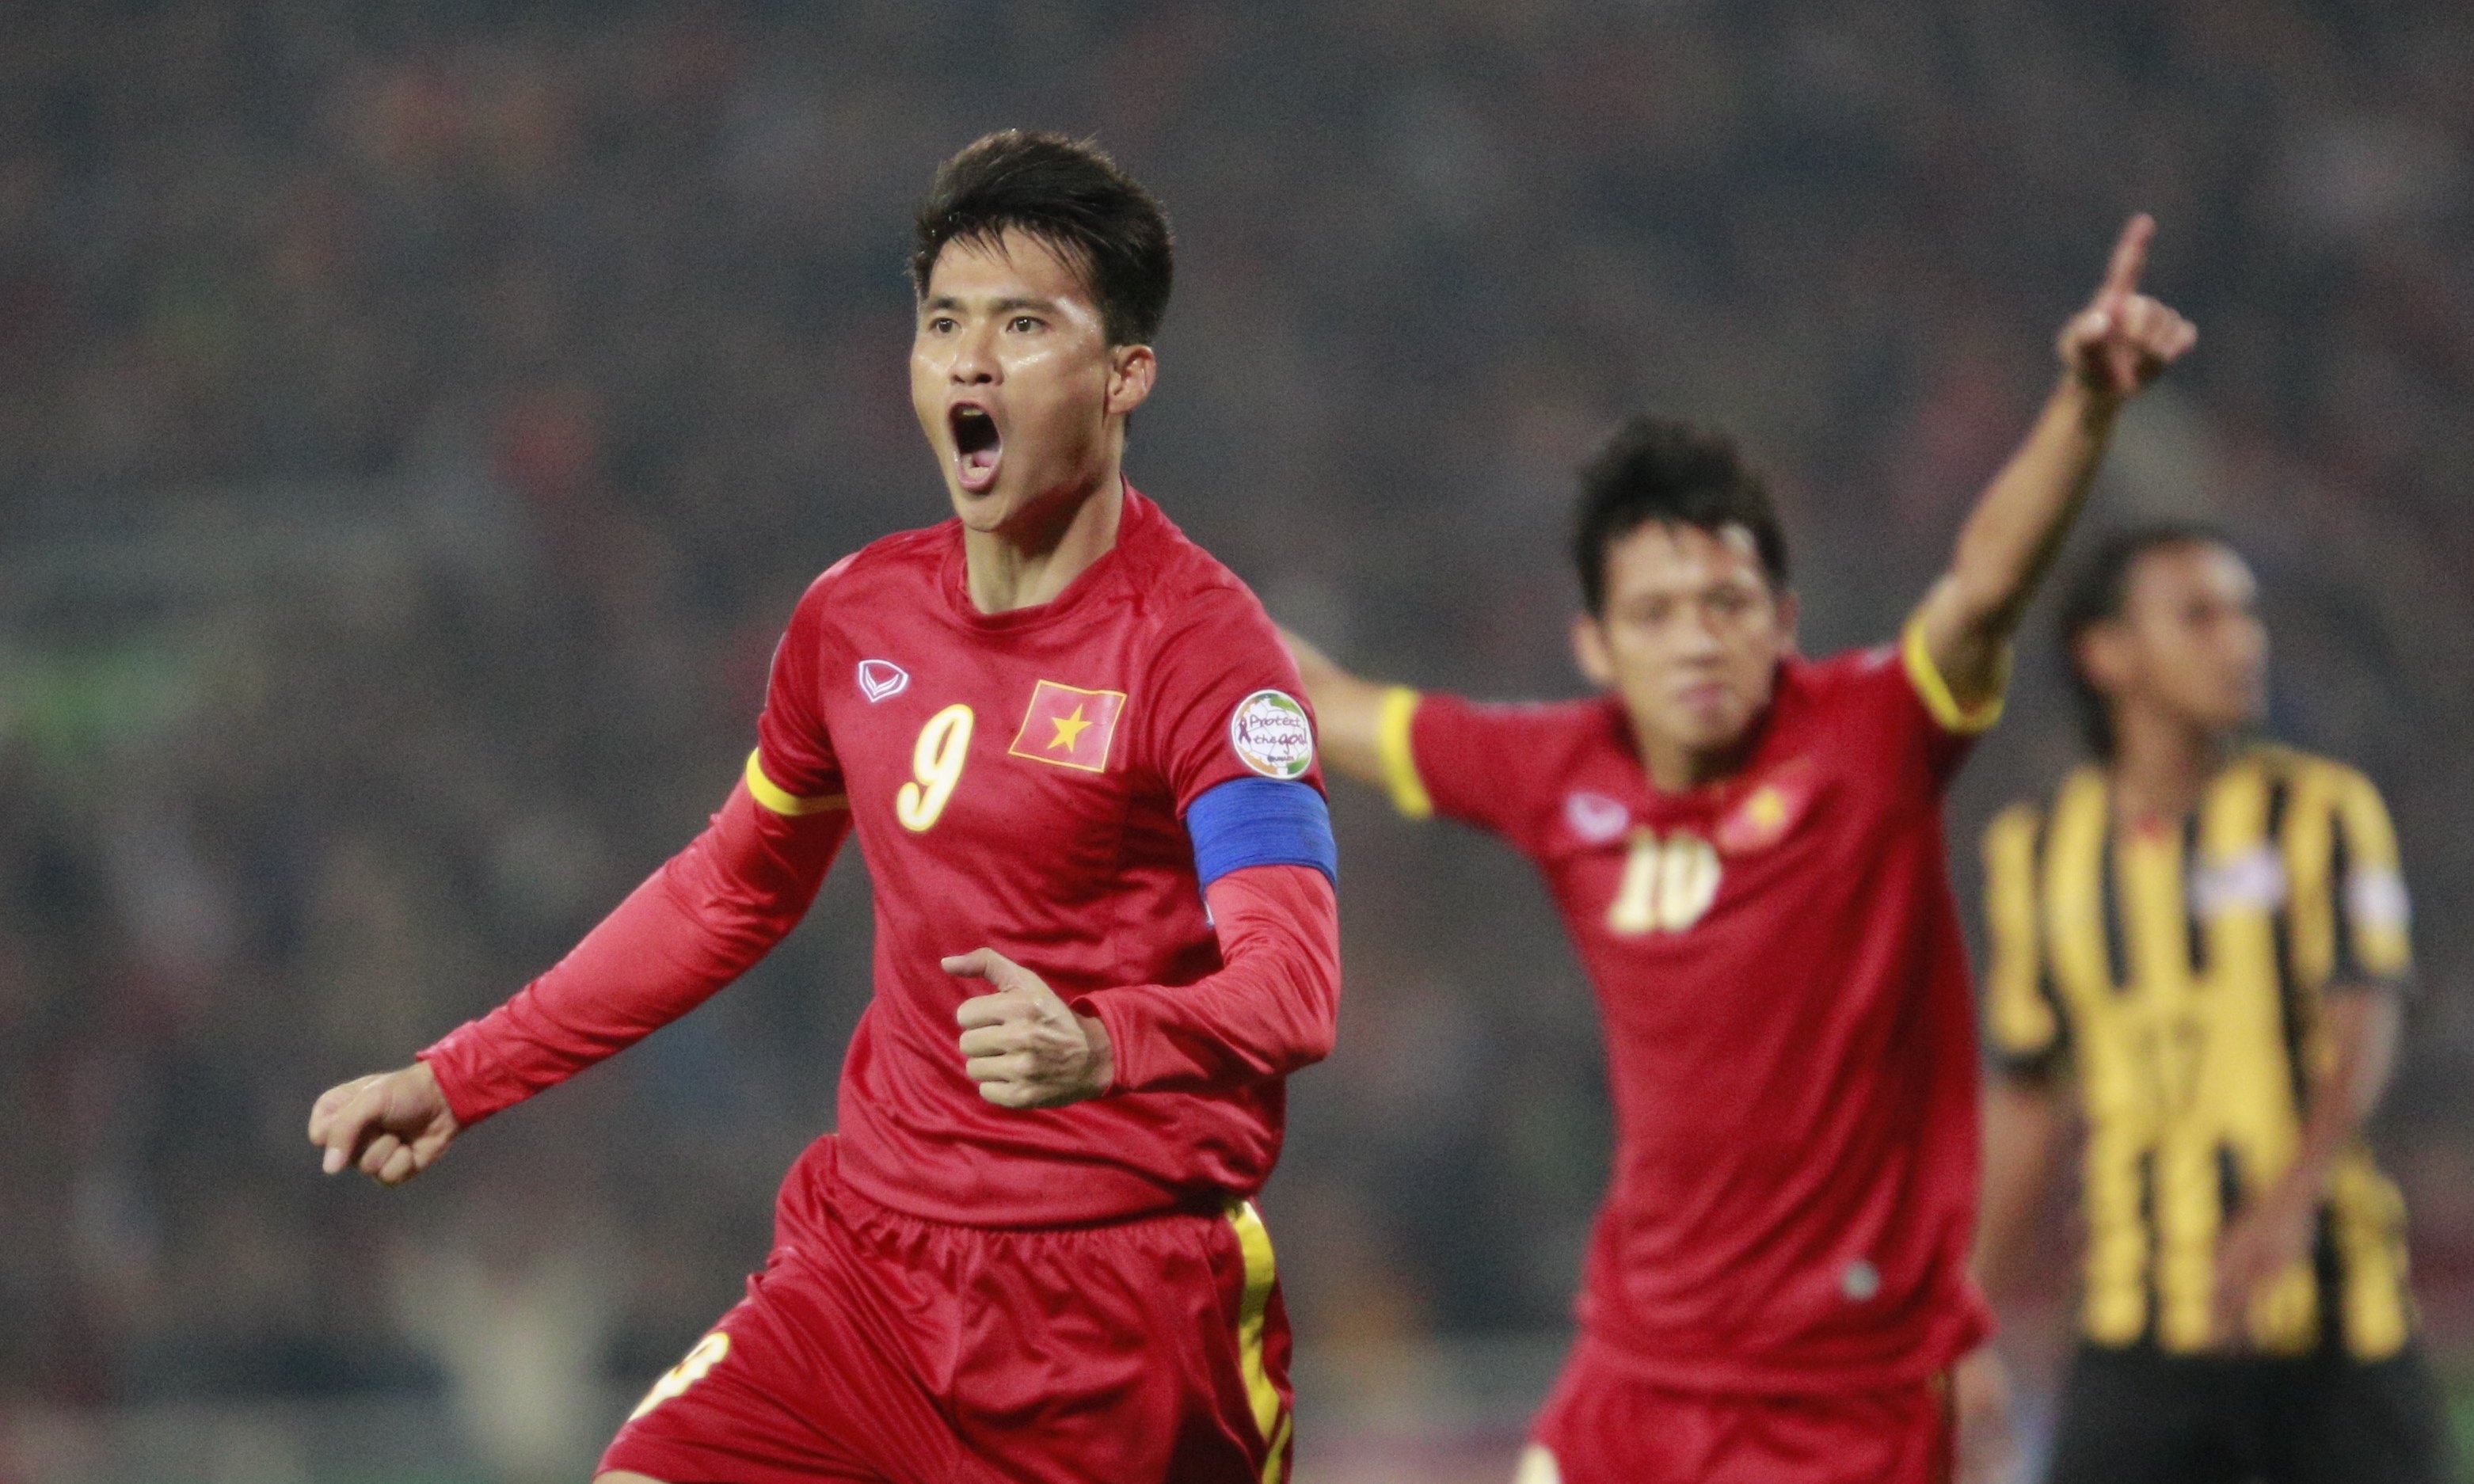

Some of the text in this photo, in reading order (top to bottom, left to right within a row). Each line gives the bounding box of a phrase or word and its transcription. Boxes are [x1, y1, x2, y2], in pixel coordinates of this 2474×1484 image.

[1250, 713, 1300, 728] Protect
[1254, 734, 1276, 744] the
[896, 703, 974, 831] 9
[1606, 825, 1722, 934] 10
